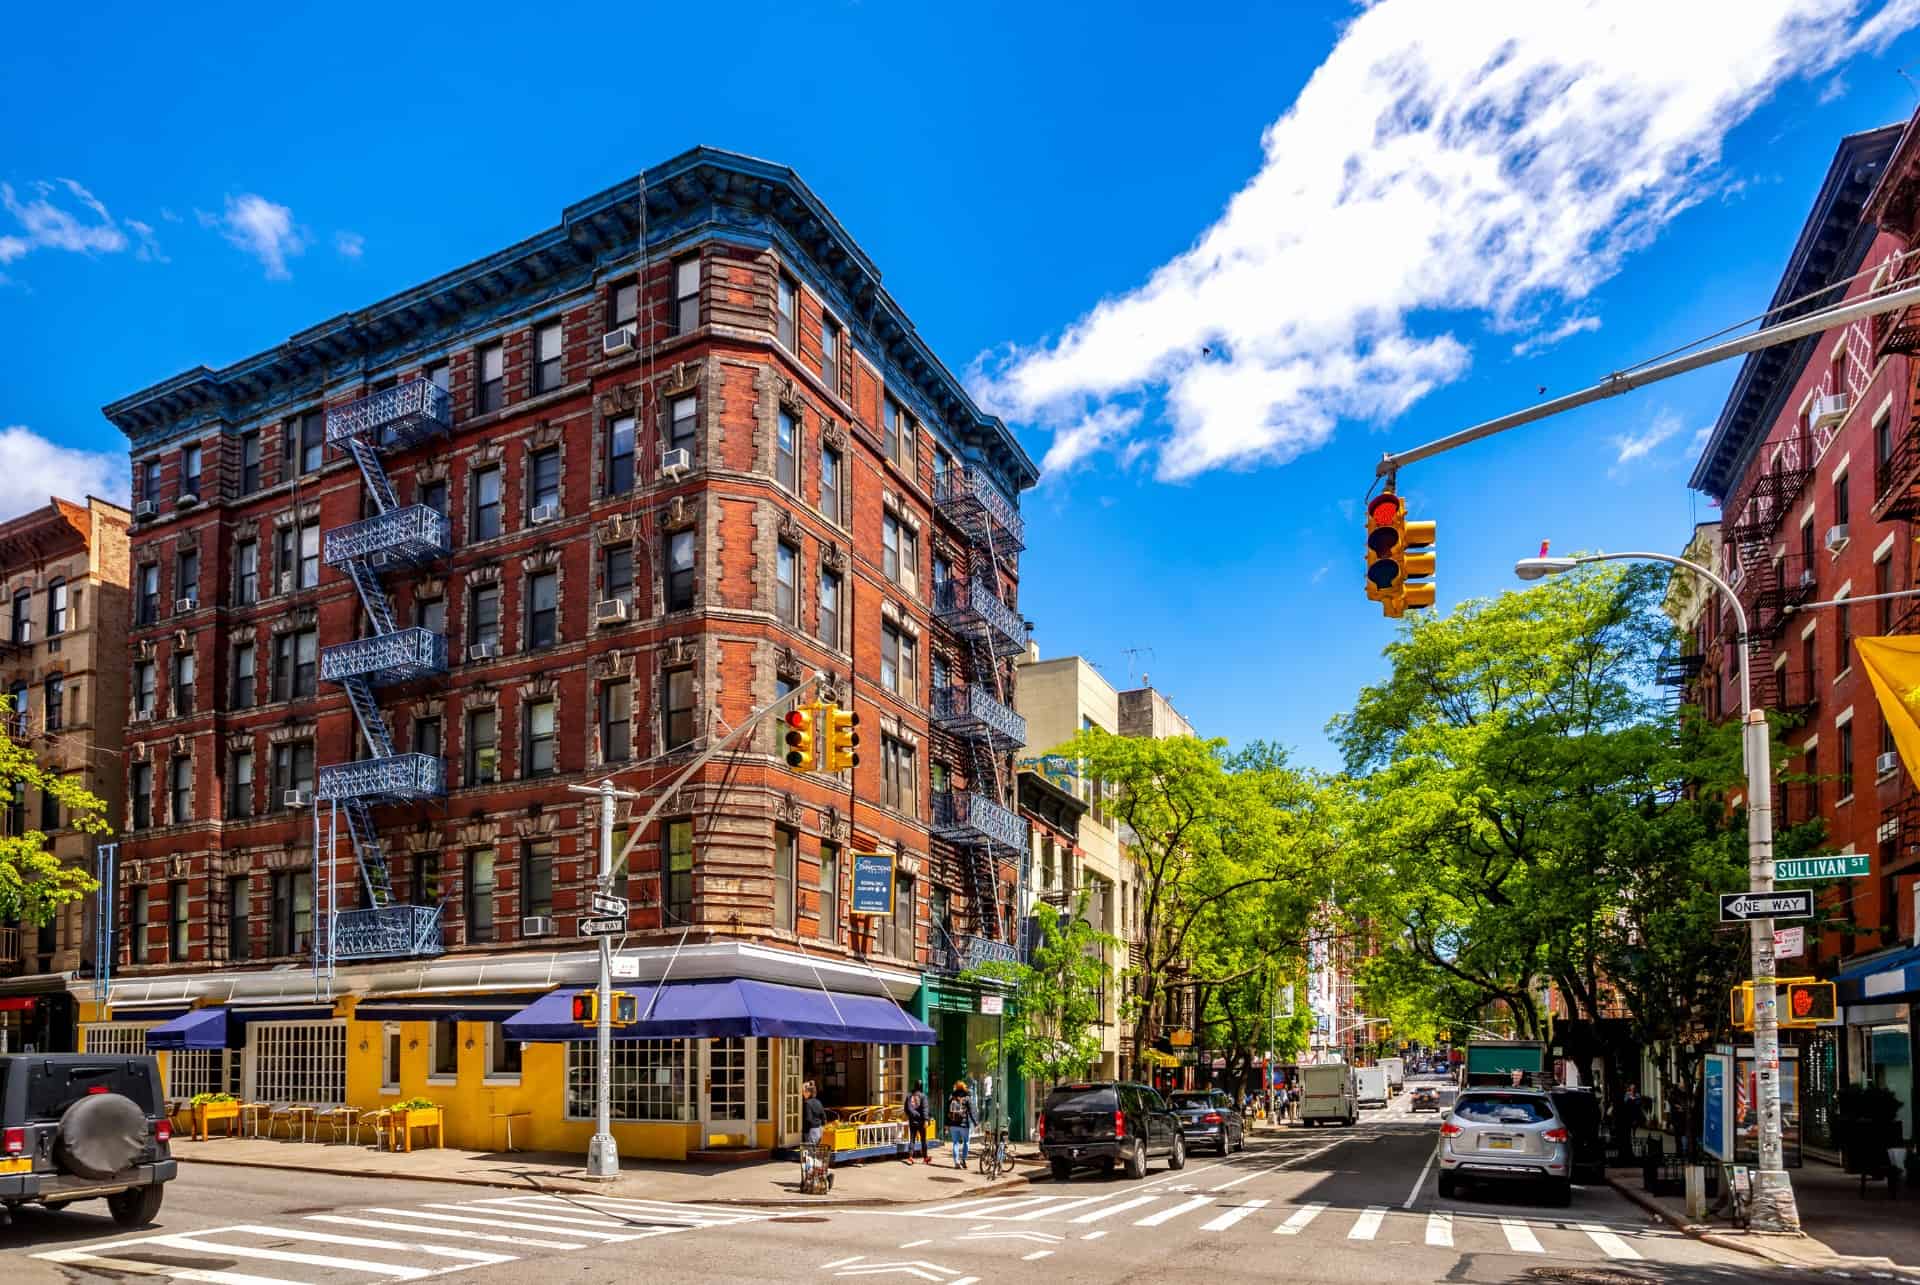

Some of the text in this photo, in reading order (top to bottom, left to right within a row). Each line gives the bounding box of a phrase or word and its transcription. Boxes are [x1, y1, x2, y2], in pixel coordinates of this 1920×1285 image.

[1778, 857, 1865, 878] SULLIVAN ST
[1735, 899, 1800, 913] ONE WAY
[604, 921, 619, 930] WAY
